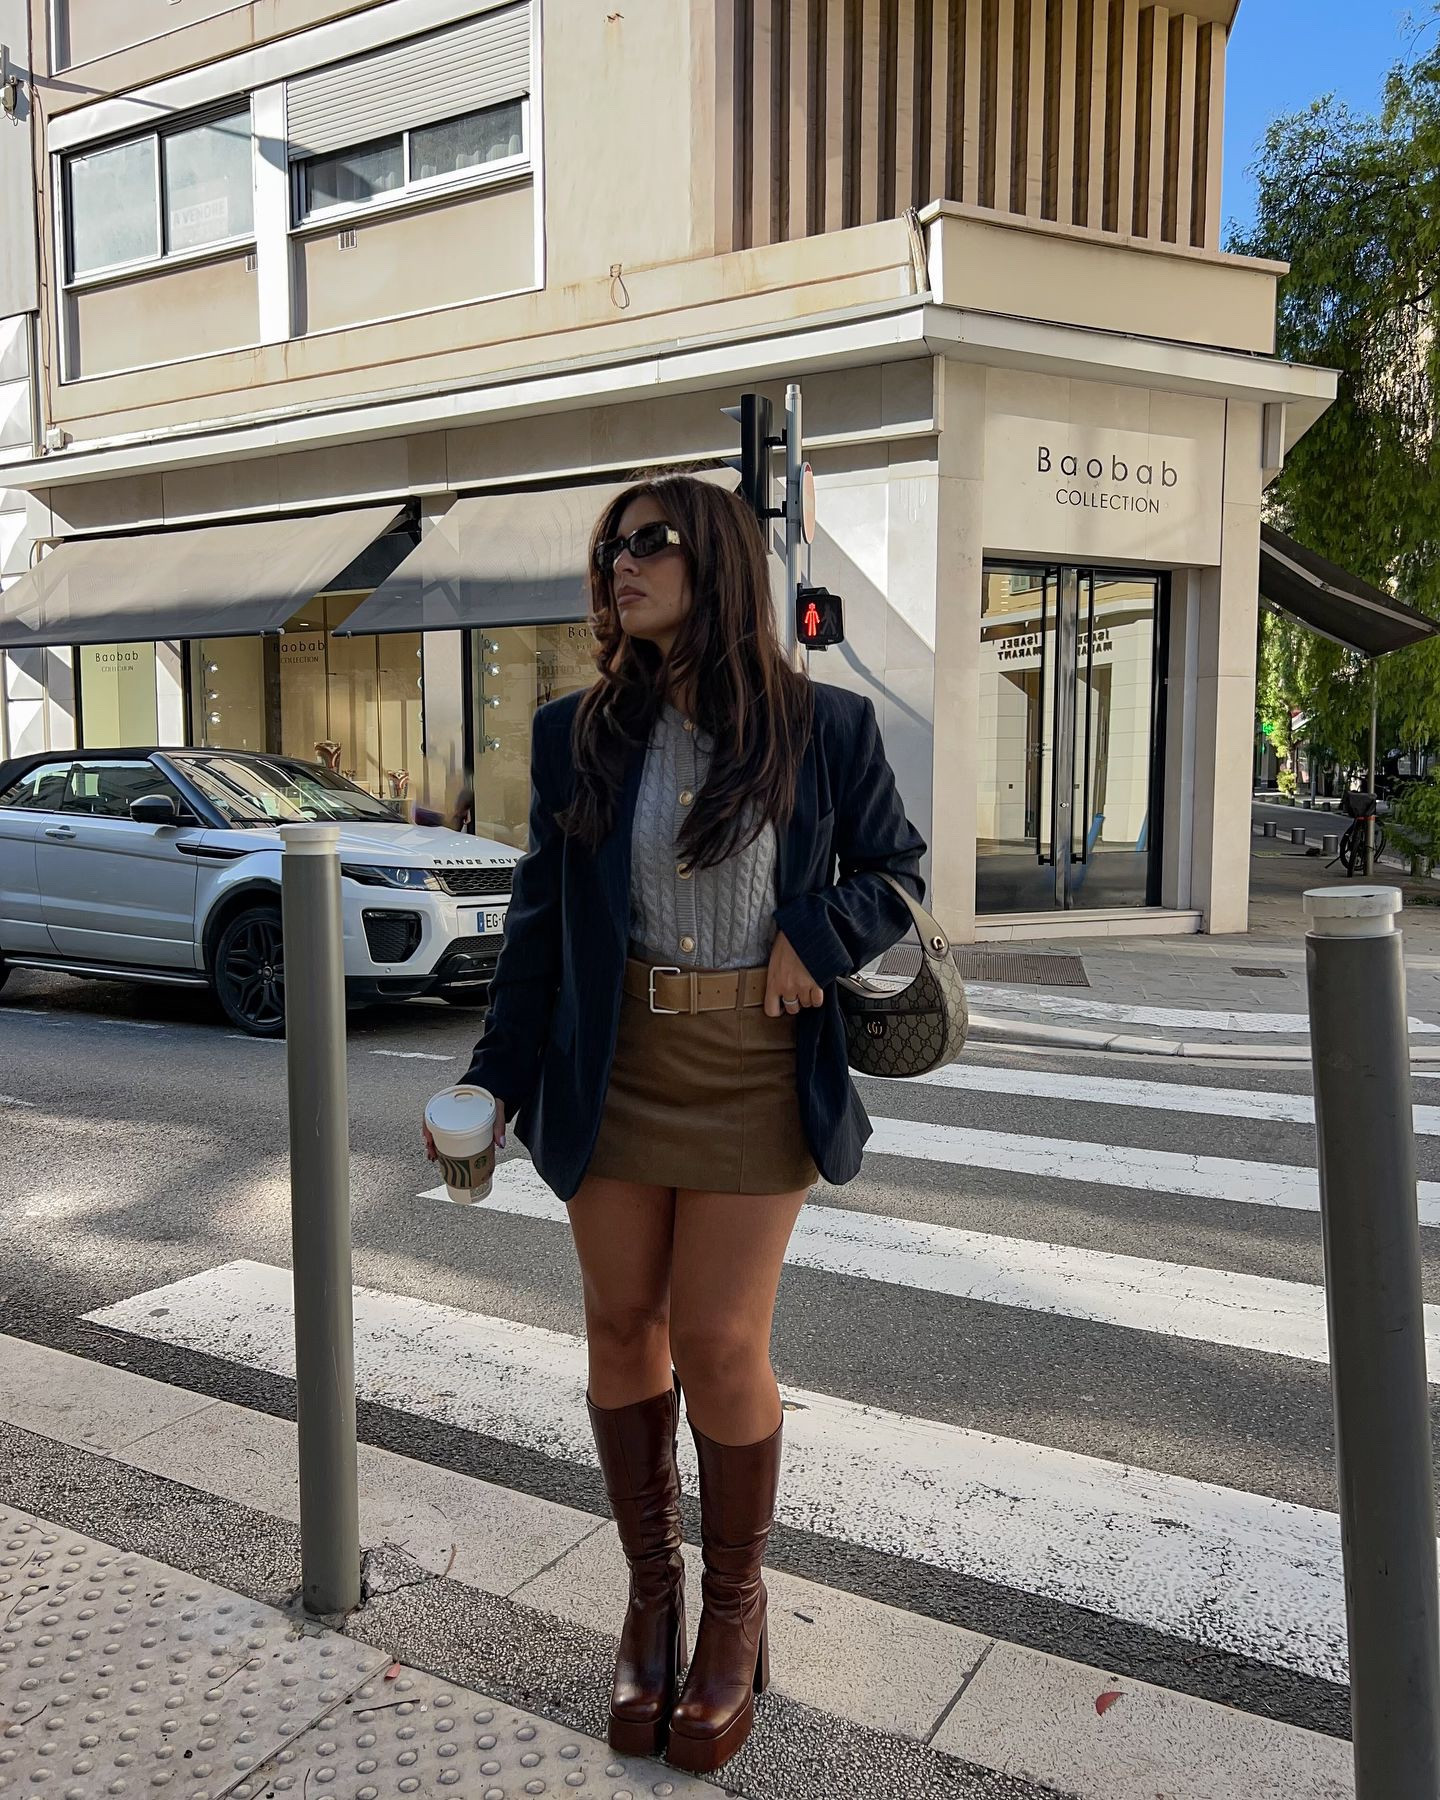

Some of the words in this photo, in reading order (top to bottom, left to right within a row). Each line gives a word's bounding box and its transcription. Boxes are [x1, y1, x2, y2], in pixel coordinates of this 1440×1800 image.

[1037, 446, 1178, 488] Baobab
[1055, 488, 1160, 514] COLLECTION
[95, 651, 139, 662] Baobab
